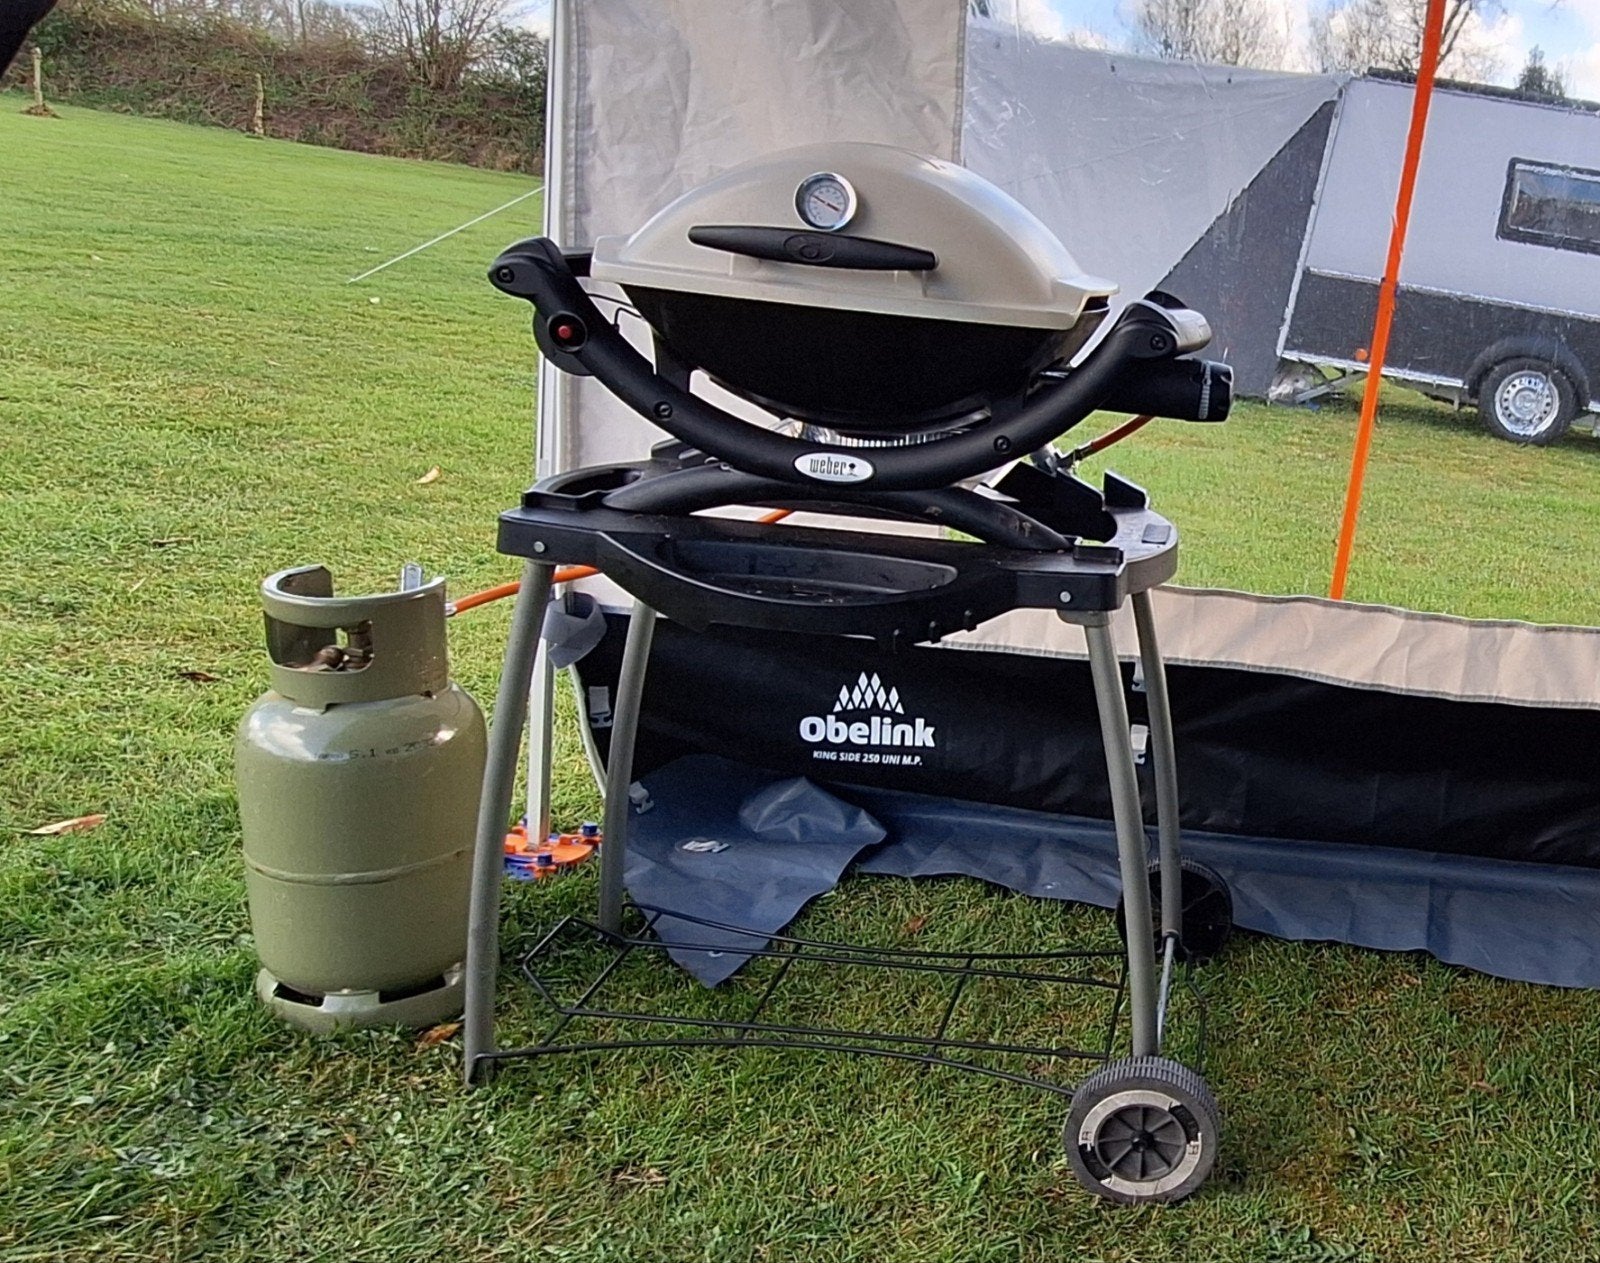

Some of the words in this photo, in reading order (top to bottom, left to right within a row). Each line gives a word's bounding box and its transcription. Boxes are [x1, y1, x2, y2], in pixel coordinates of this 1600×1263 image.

[810, 456, 846, 474] weber
[799, 714, 936, 747] Obelink
[813, 750, 838, 760] KING
[839, 752, 861, 762] SIDE
[862, 753, 880, 763] 250
[882, 754, 900, 765] UNI
[902, 756, 923, 766] M.P.
